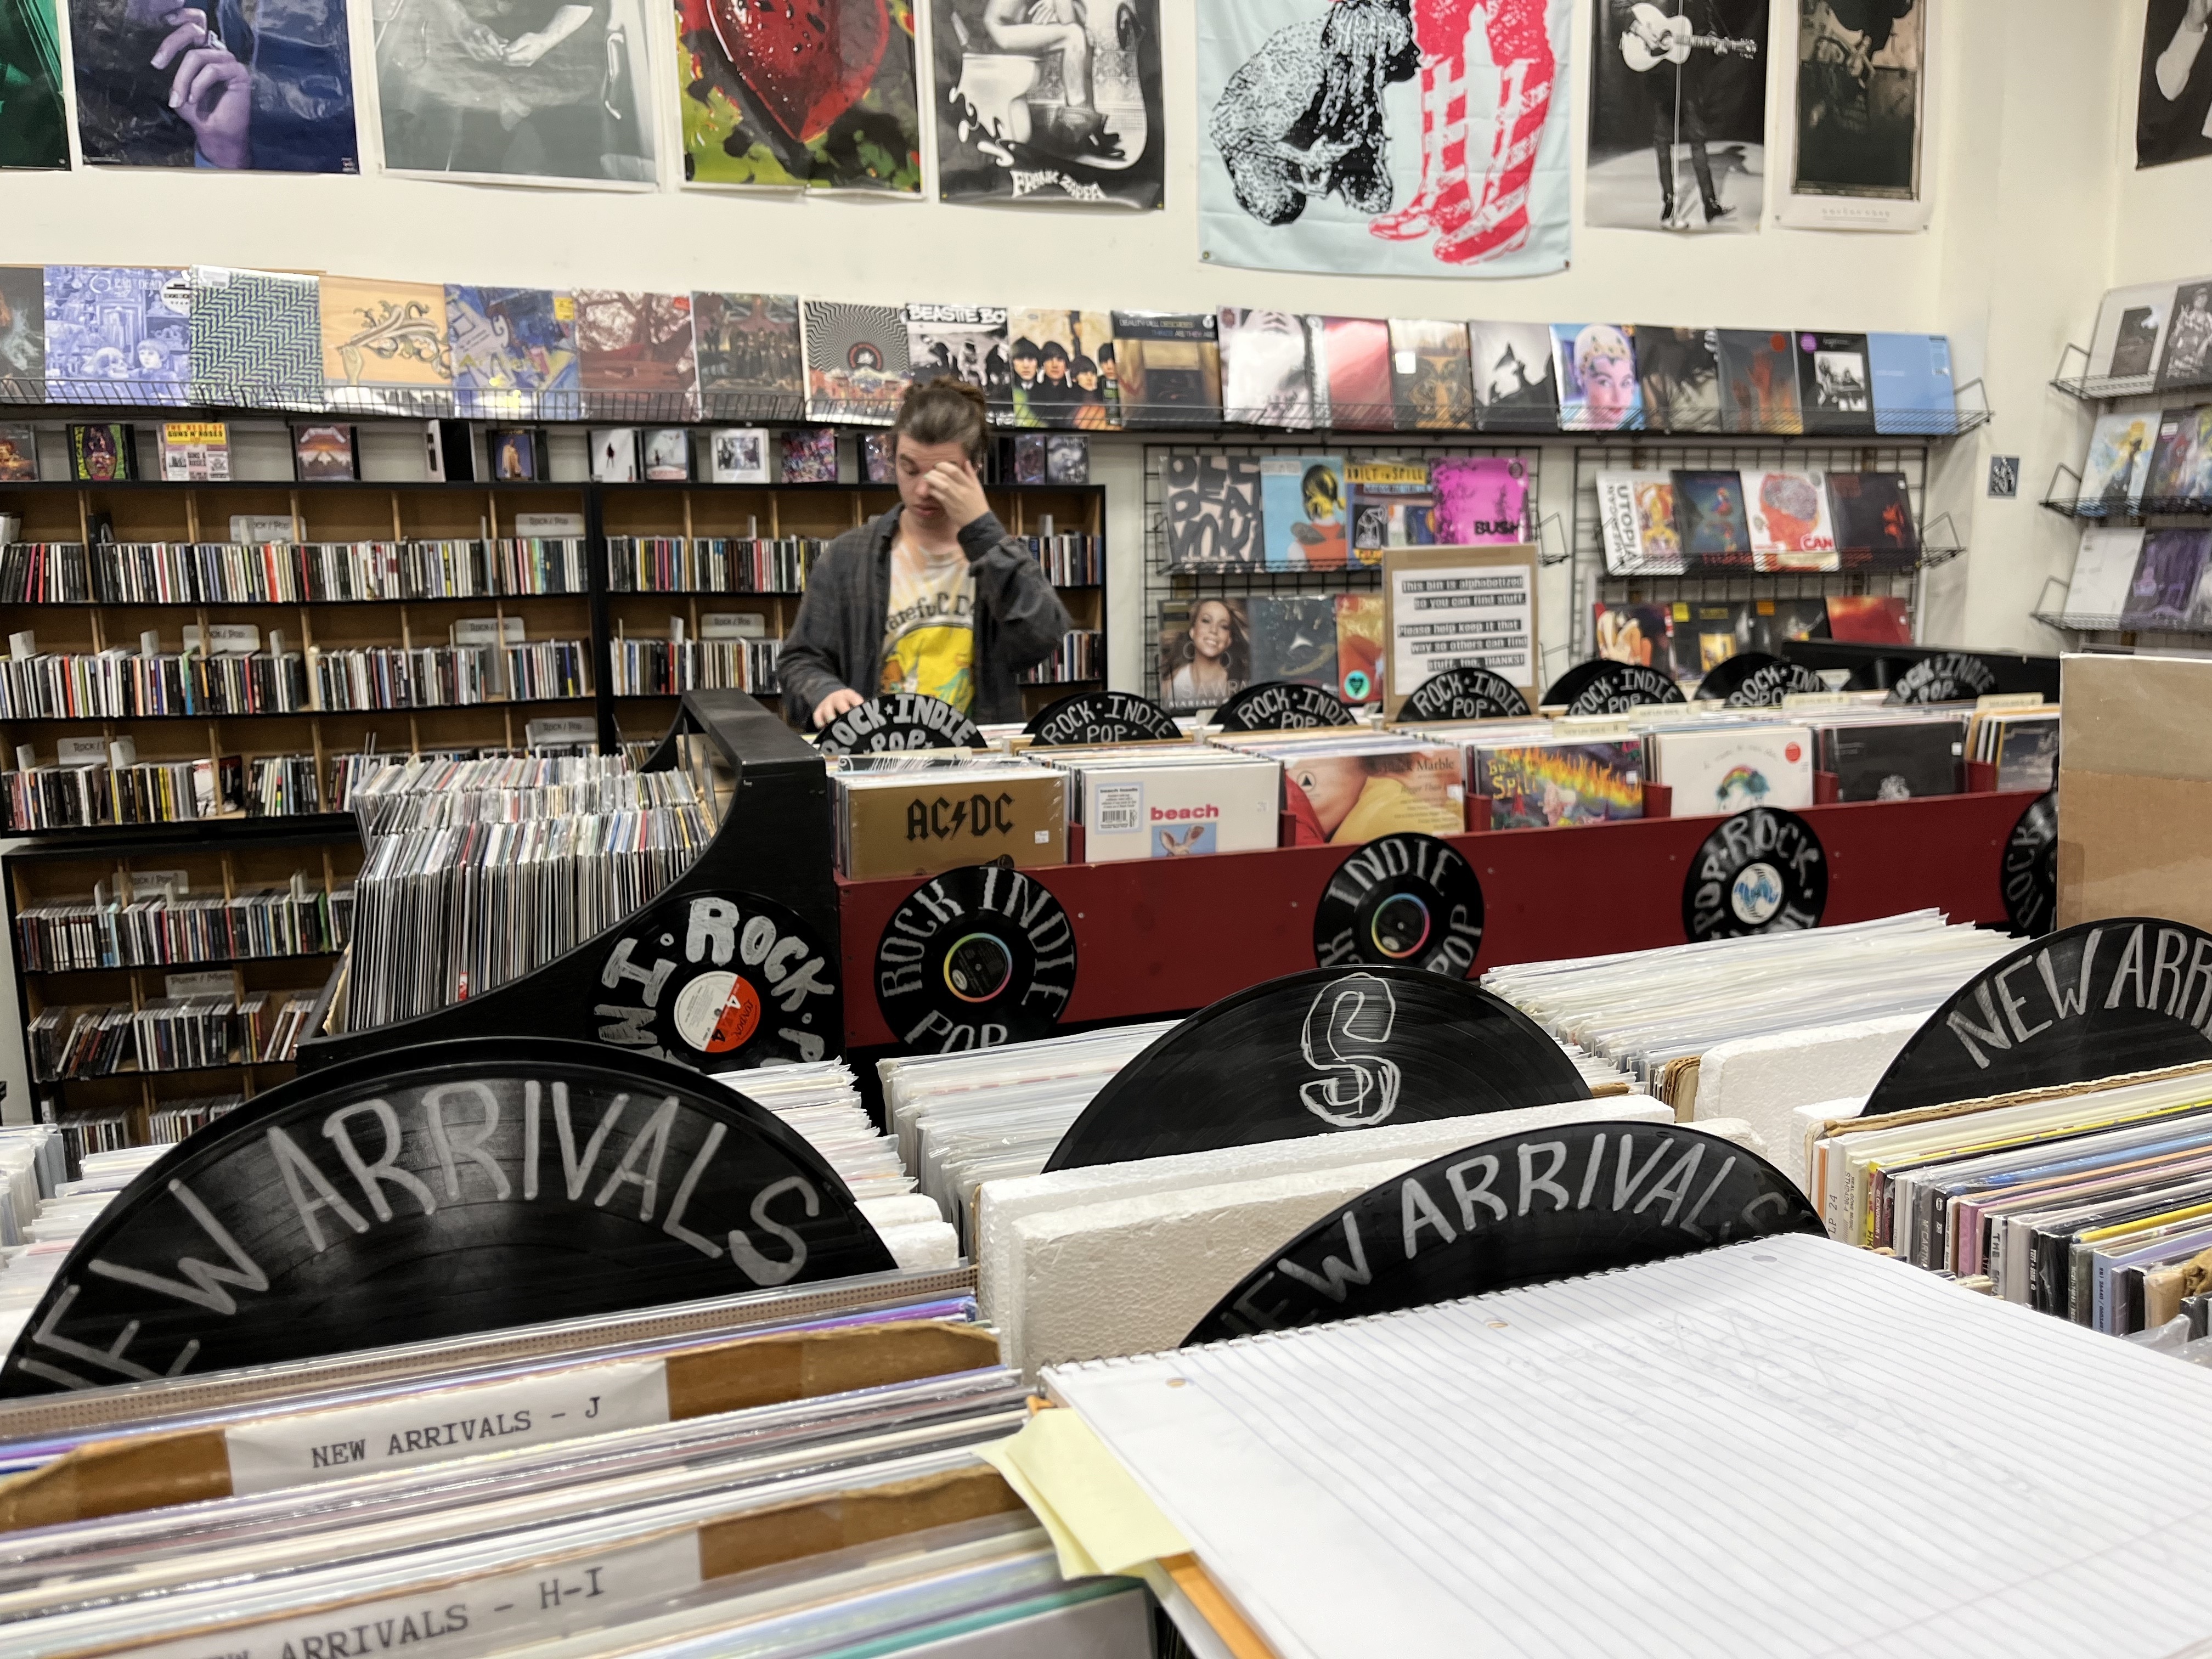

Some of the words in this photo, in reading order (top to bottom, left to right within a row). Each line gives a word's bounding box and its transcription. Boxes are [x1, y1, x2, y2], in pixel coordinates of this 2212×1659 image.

[1009, 168, 1060, 199] FRANK
[1058, 173, 1108, 201] ZAPPA
[906, 304, 979, 323] BEASTIE
[979, 308, 1006, 324] BO
[1804, 537, 1832, 548] CAN
[1427, 580, 1444, 590] bin
[1446, 580, 1457, 590] is
[1430, 599, 1448, 608] you
[1452, 597, 1470, 606] can
[1474, 596, 1495, 605] find
[1412, 644, 1432, 653] way
[1435, 642, 1447, 651] so
[1450, 640, 1482, 651] others
[1486, 639, 1504, 648] can
[1508, 636, 1528, 648] find
[1434, 624, 1455, 635] help
[1459, 623, 1483, 633] keep
[1486, 622, 1494, 631] it
[1498, 620, 1518, 630] that
[1169, 699, 1216, 708] MARIAH
[1413, 674, 1464, 717] ROCK
[1467, 671, 1527, 718] INDIE
[1570, 678, 1612, 715] ROCK
[1620, 668, 1678, 704] INDIE
[1607, 693, 1641, 713] POP
[1730, 665, 1781, 706] ROCK
[821, 697, 887, 755] ROCK
[893, 693, 977, 747] INDIE
[1041, 699, 1094, 746] ROCK
[1107, 694, 1175, 740] INDIE
[1238, 689, 1289, 730] ROCK
[1280, 711, 1317, 729] POP
[1452, 697, 1487, 719] POP
[870, 729, 927, 752] POP
[1086, 724, 1127, 744] POP
[1416, 757, 1455, 771] Marble
[1150, 803, 1219, 821] beach
[1722, 816, 1818, 884] ROCK
[1324, 838, 1463, 913] INDIE
[2005, 824, 2039, 929] ROCK
[685, 896, 836, 1012] ROCK
[881, 879, 964, 997] ROCK
[978, 867, 1076, 1018] INDIE
[1426, 903, 1482, 975] POP
[1946, 928, 2104, 1069] NEW
[731, 998, 754, 1042] LONDON
[903, 1009, 1008, 1054] POP
[1300, 971, 1402, 1127] S
[266, 1079, 820, 1286] ARRIVALS
[1829, 1194, 1837, 1211] 24
[1828, 1217, 1837, 1235] LP
[1992, 1233, 2001, 1257] THE
[311, 1437, 367, 1469] NEW
[386, 1409, 533, 1458] ARRIVALS
[584, 1396, 602, 1420] J
[280, 1605, 470, 1659] ARRIVALS
[538, 1566, 606, 1611] H-I
